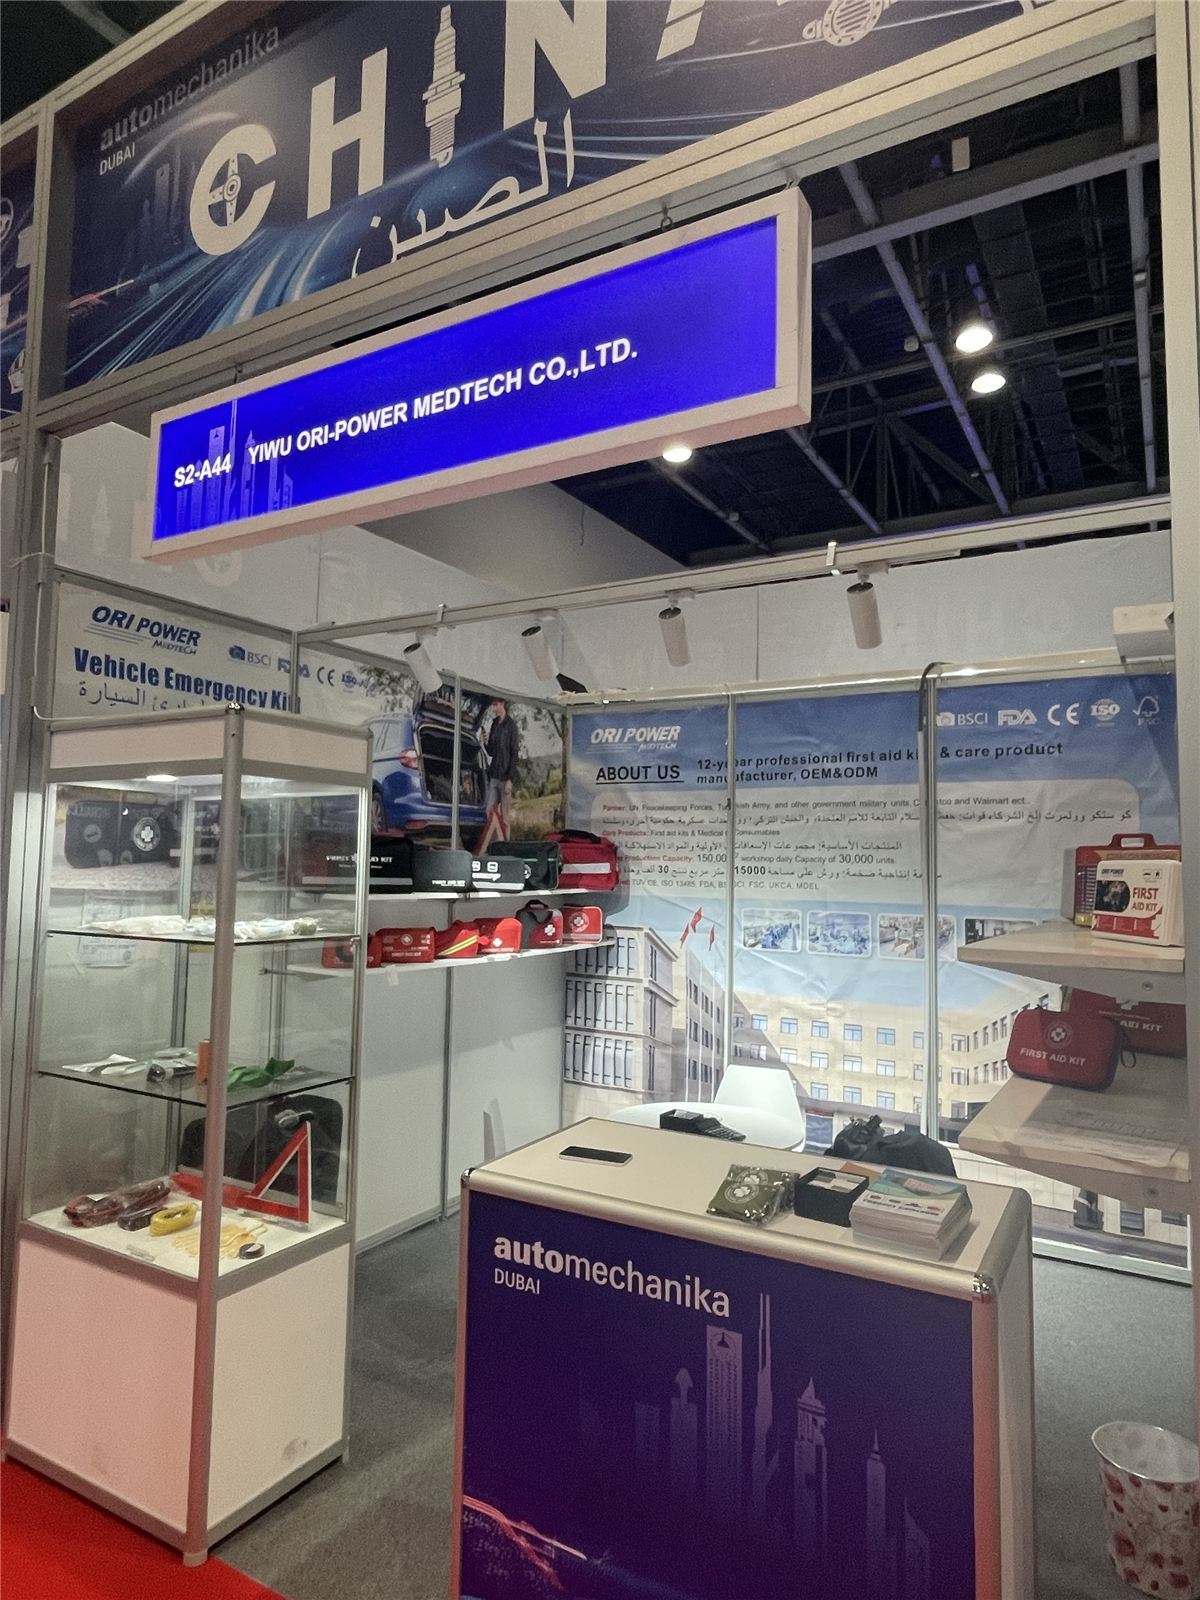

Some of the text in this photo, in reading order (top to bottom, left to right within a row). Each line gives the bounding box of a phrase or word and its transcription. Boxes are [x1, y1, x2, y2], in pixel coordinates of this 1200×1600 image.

[100, 24, 280, 151] automechanika
[99, 143, 136, 175] DUBAI
[174, 337, 638, 488] S2-A44 YIWU ORI-POWER MEDTECH CO.,LTD.
[91, 605, 202, 647] ORI POWER
[73, 647, 160, 686] Vehicle
[164, 667, 268, 711] Emergency
[270, 689, 293, 712] Ki
[247, 652, 271, 666] BSCI
[317, 666, 335, 688] CE
[80, 681, 145, 706] السيارة
[957, 712, 988, 725] BSCI
[997, 708, 1037, 726] FDA
[1047, 703, 1080, 726] CE
[1090, 703, 1120, 716] ISO
[591, 725, 681, 744] ORI POWER
[756, 753, 842, 768] professional
[847, 751, 875, 763] first
[879, 749, 901, 761] aid
[906, 749, 919, 761] ki
[940, 745, 950, 759] &
[955, 747, 990, 758] care
[995, 743, 1063, 759] product
[596, 765, 681, 781] ABOUT US
[801, 766, 878, 780] OEM&ODM
[791, 800, 809, 808] other
[812, 799, 856, 809] government
[954, 797, 970, 805] and
[973, 797, 1009, 806] Walmart
[698, 829, 723, 837] Medical
[776, 854, 793, 863] daily
[795, 854, 825, 864] Capacity
[828, 853, 836, 862] of
[839, 854, 874, 864] 30,000
[657, 865, 669, 873] 30
[734, 865, 766, 875] 15000
[661, 879, 673, 887] ISO
[1132, 887, 1159, 900] FIRST
[1132, 902, 1158, 911] AID KIT
[1142, 1023, 1163, 1032] KIT
[1019, 1047, 1087, 1067] FIRST AID KIT
[494, 1233, 731, 1317] automechanika
[494, 1268, 541, 1296] DUBAI
